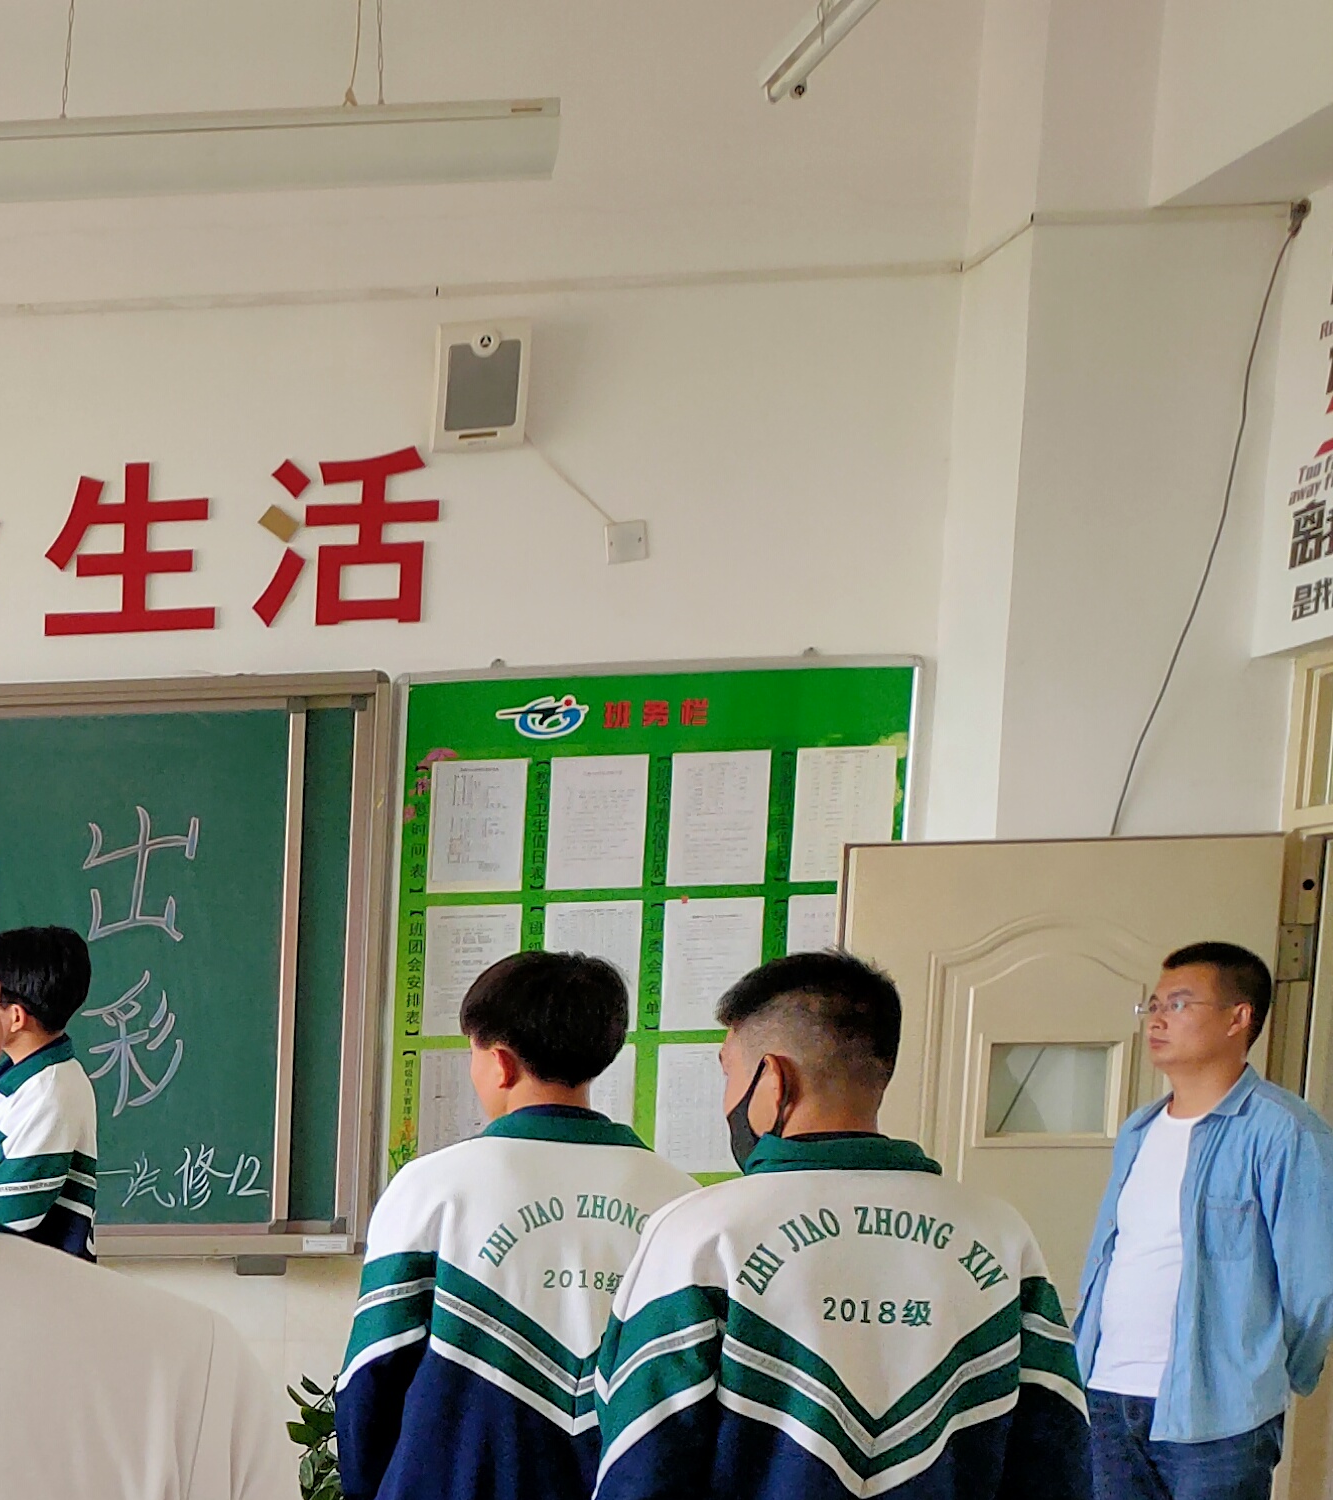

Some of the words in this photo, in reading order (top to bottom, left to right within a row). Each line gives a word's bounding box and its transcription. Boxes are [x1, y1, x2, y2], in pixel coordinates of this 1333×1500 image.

[603, 698, 709, 729] 班务栏
[477, 1223, 519, 1268] ZHI
[517, 1196, 565, 1233] JIAO
[576, 1194, 651, 1236] ZHONG
[735, 1242, 786, 1297] ZHI
[778, 1207, 841, 1254] JIAO
[853, 1205, 955, 1250] ZHONG
[957, 1240, 1010, 1292] XIN
[822, 1296, 933, 1327] 2018级
